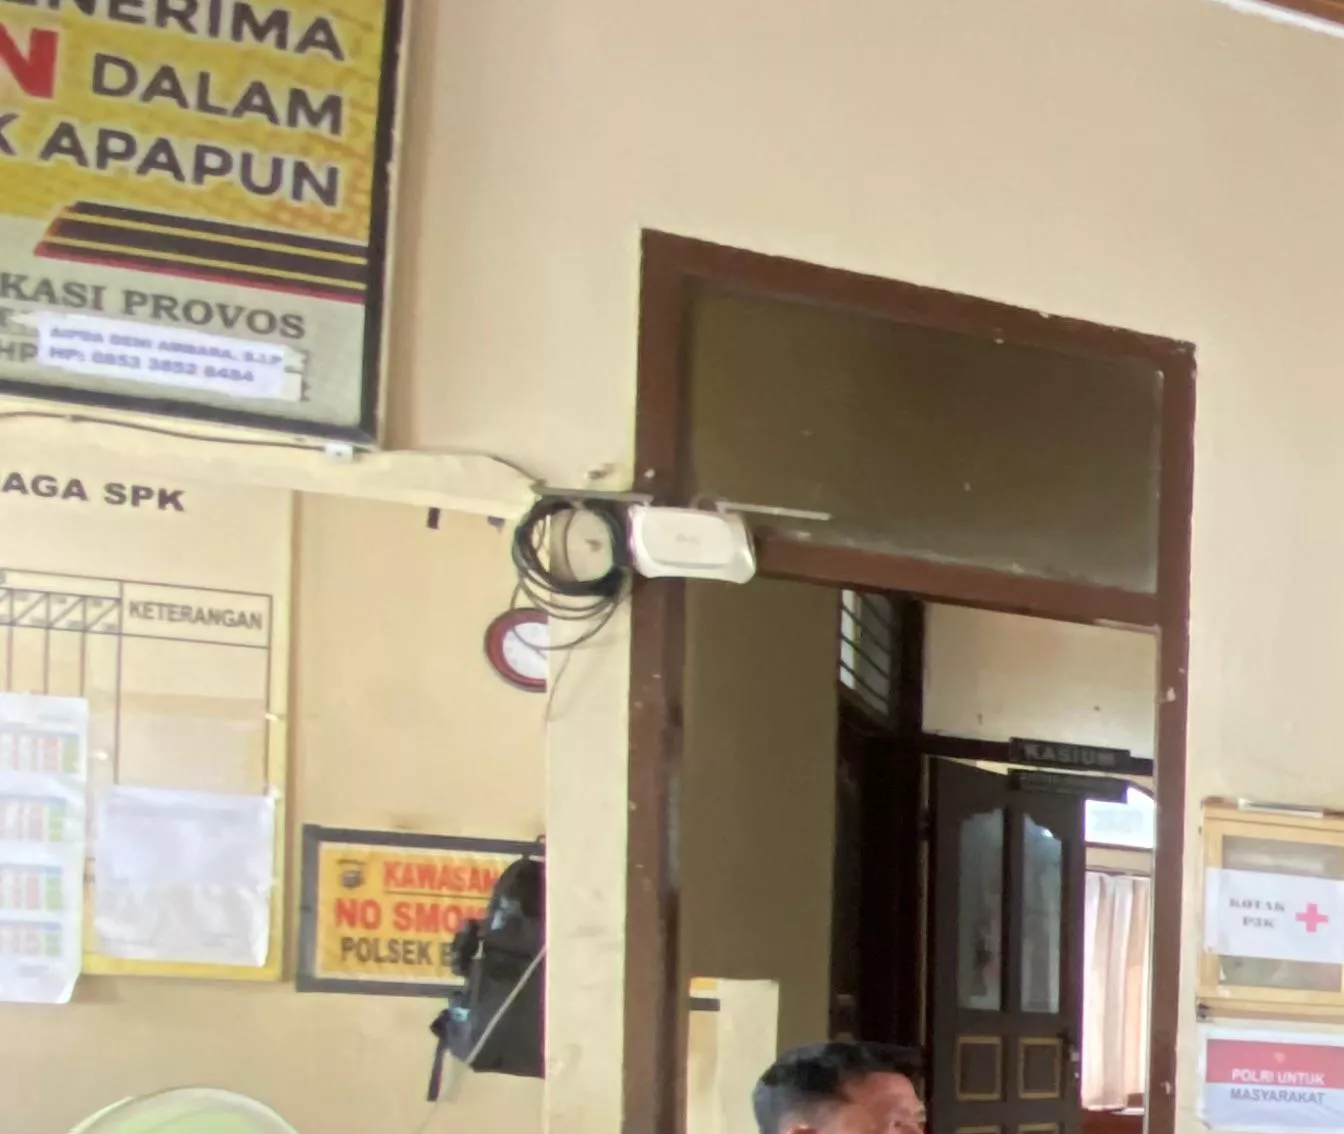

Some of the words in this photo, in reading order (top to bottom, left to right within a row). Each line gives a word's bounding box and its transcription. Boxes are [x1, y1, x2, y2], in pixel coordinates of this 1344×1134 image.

[92, 53, 342, 136] DALAM
[39, 121, 340, 206] APAPUN
[0, 272, 107, 311] KASI
[121, 289, 306, 340] PROVOS
[103, 482, 187, 513] SPK
[129, 600, 263, 630] KETERANGAN
[335, 898, 382, 931] NO
[340, 937, 433, 965] POLSEK
[1231, 1068, 1275, 1083] POLRI
[1277, 1071, 1326, 1086] UNTUK
[1230, 1088, 1326, 1105] MASYARAKAT
